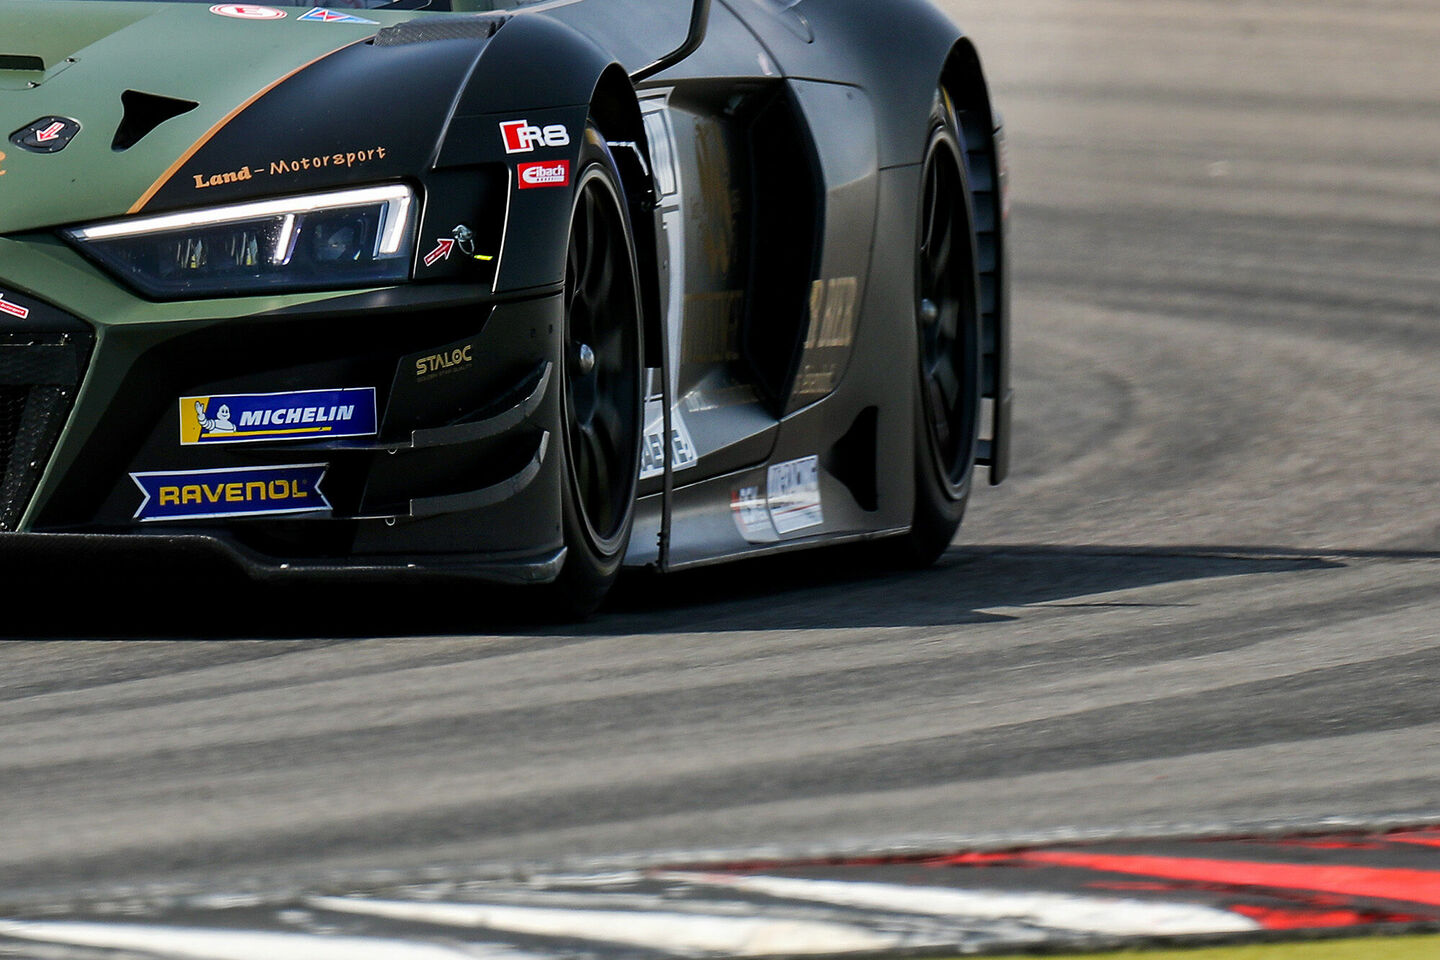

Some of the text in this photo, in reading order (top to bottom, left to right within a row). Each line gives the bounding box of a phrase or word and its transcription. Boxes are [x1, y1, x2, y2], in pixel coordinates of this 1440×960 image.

[504, 121, 570, 151] R8
[415, 344, 473, 376] STALOC
[239, 403, 355, 428] MICHELIN
[159, 477, 309, 507] RAVENOL
